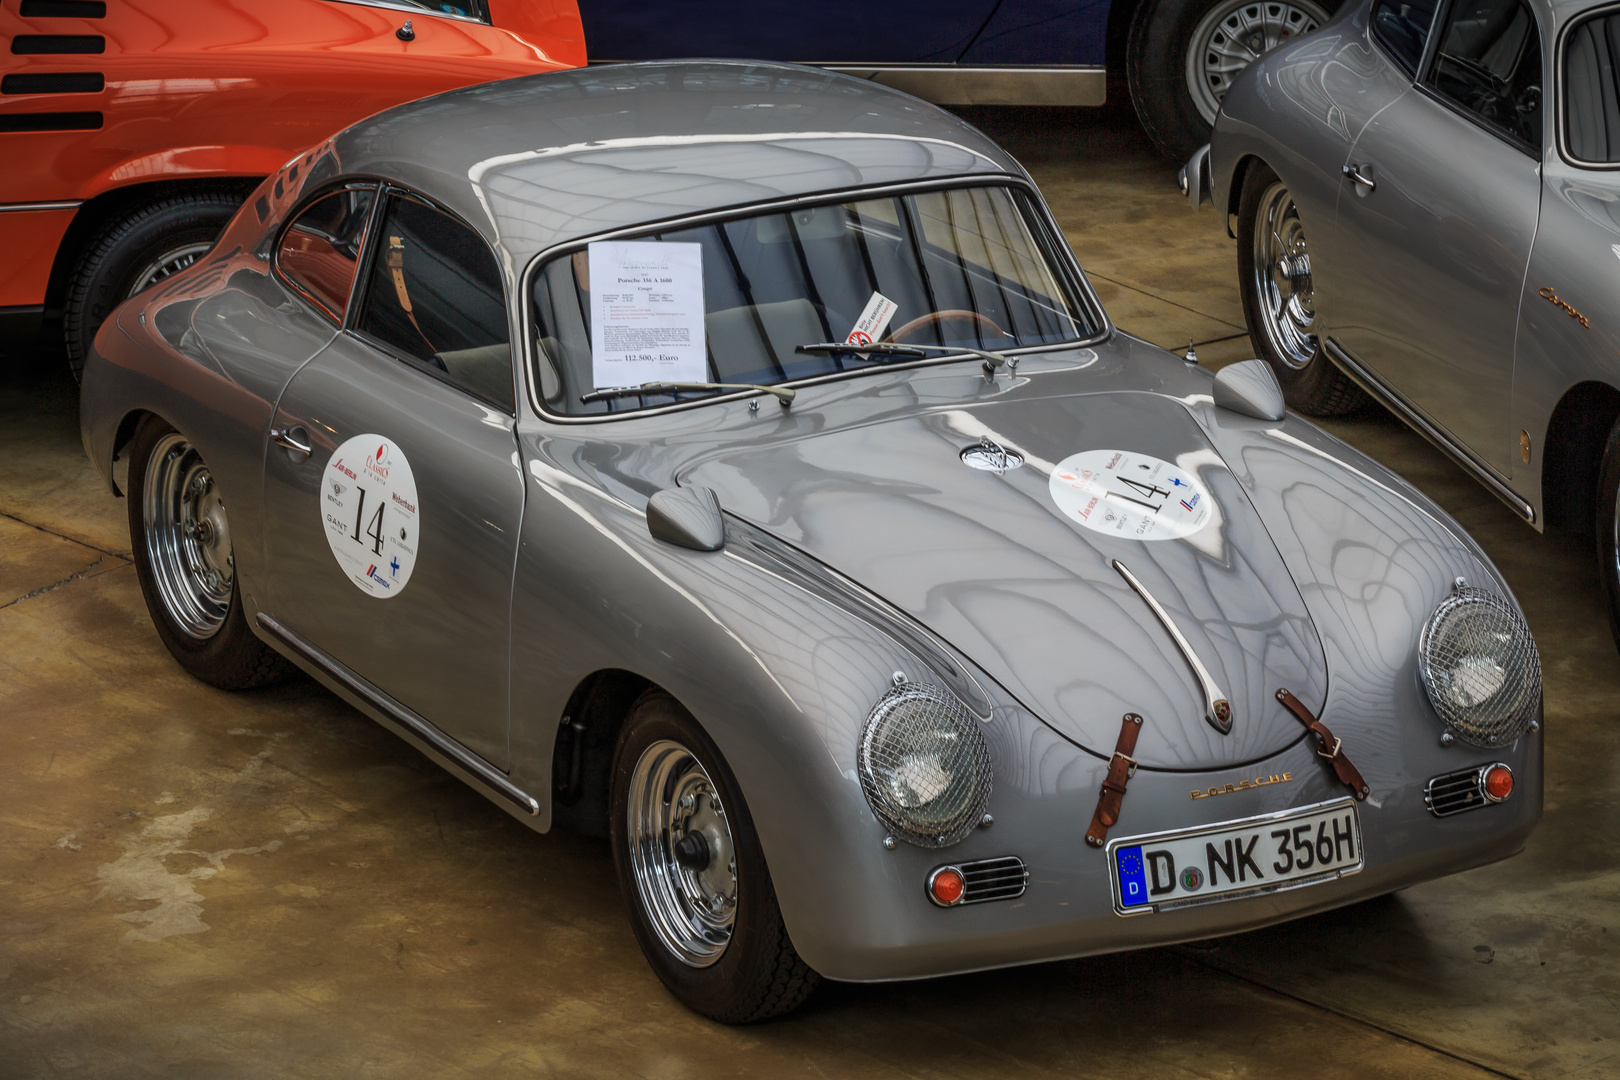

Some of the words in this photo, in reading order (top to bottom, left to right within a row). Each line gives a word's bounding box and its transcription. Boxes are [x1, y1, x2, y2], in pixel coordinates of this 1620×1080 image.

[1539, 287, 1591, 329] Carrera
[327, 493, 343, 508] BENTLEY
[392, 491, 416, 514] Weberbank
[1104, 475, 1171, 514] 14
[326, 513, 347, 532] GANT
[350, 486, 385, 557] 14
[1189, 772, 1293, 800] PORSCHE
[1145, 849, 1177, 896] D
[1206, 834, 1264, 886] NK
[1271, 815, 1355, 875] 356H
[1129, 881, 1139, 895] D
